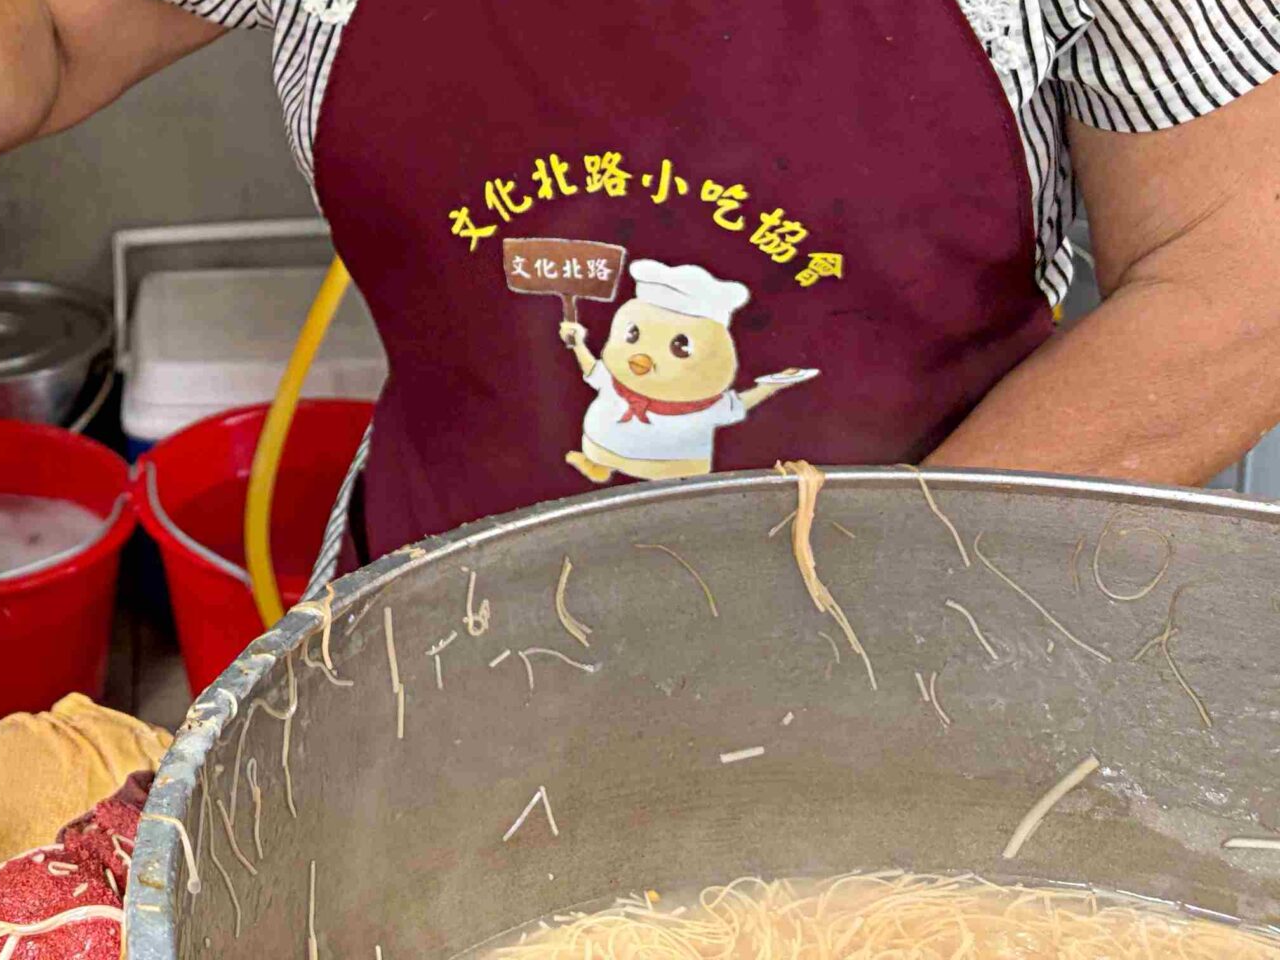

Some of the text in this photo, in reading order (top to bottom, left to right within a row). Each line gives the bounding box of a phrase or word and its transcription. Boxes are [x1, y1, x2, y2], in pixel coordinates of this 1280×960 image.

[449, 152, 843, 287] 文化北路小吃協會
[511, 255, 614, 281] 文化北路
